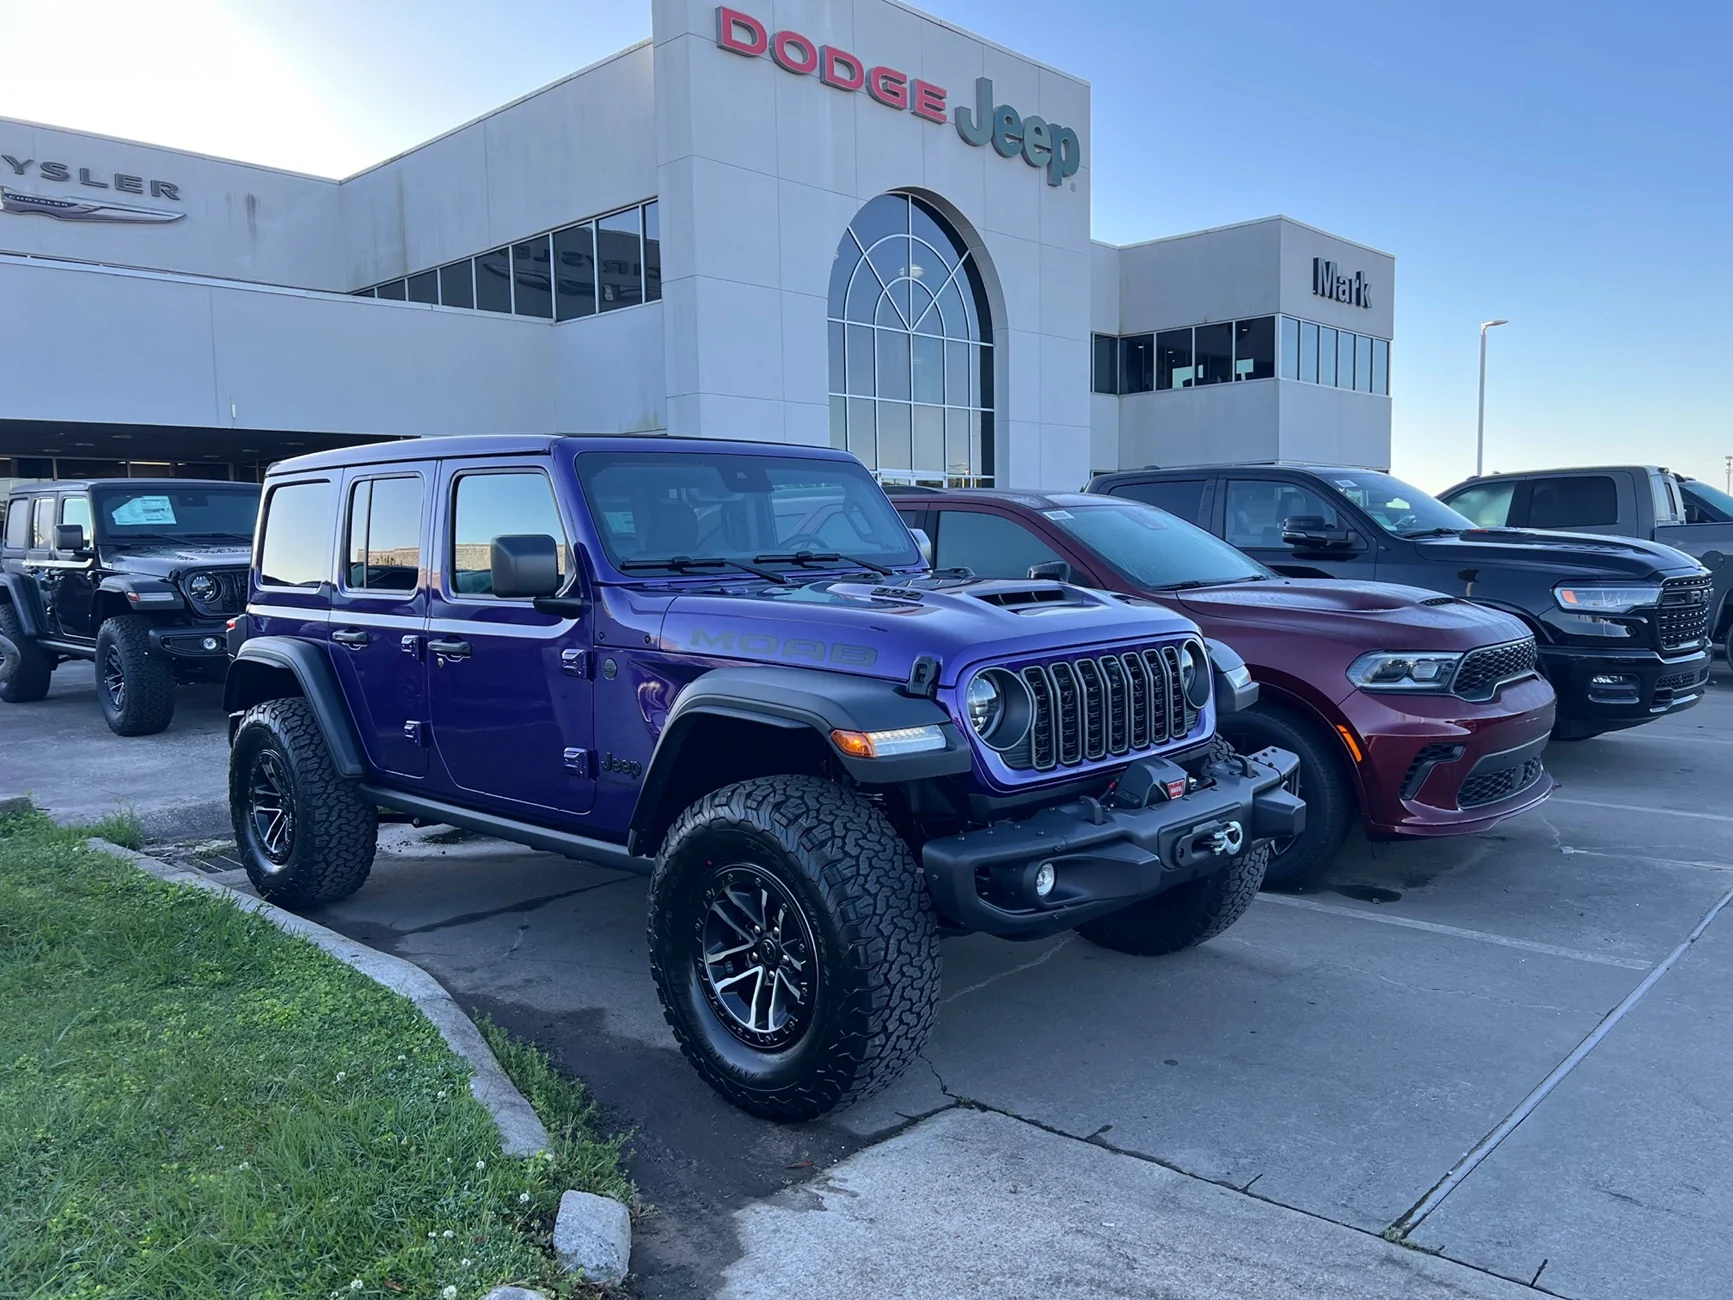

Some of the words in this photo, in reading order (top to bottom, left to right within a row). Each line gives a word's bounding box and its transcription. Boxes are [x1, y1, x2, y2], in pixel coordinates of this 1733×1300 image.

[715, 5, 947, 125] DODGE
[954, 77, 1080, 187] Jeep
[1, 154, 181, 201] YSLER
[1313, 257, 1372, 309] Mark
[689, 628, 878, 667] MOAB
[601, 752, 641, 780] Jeep
